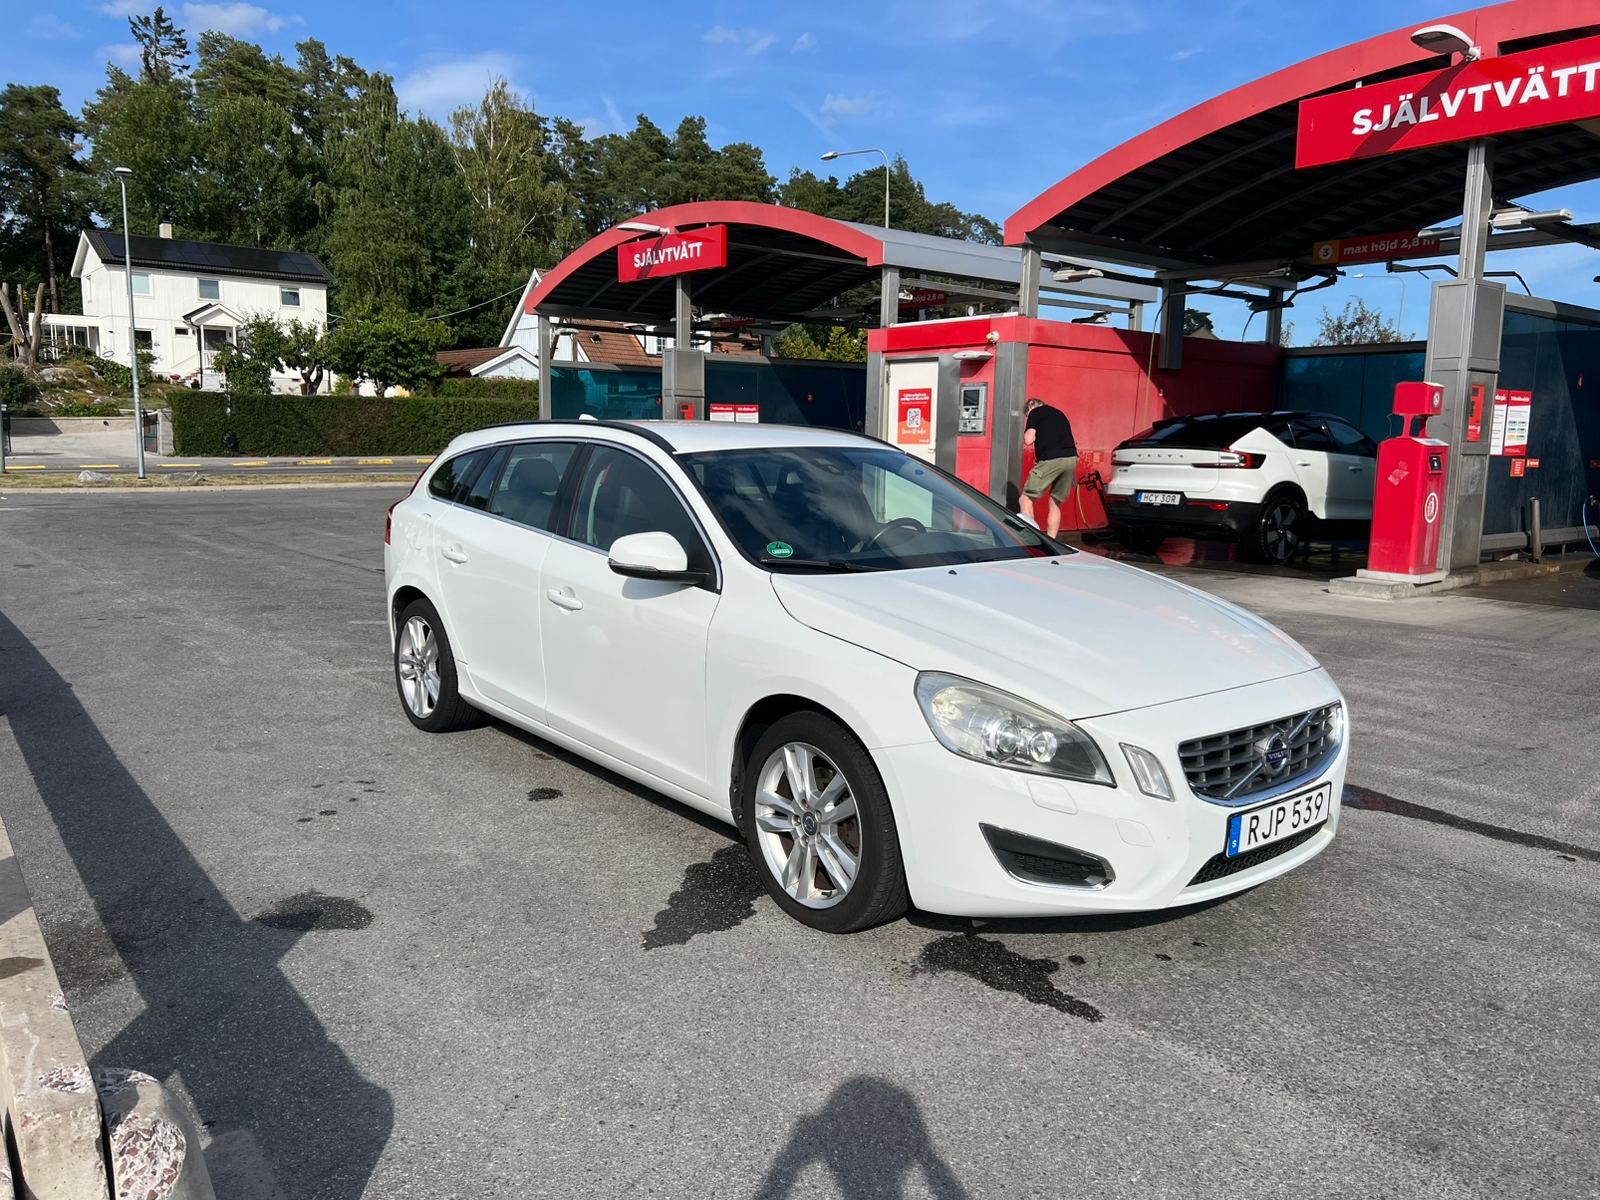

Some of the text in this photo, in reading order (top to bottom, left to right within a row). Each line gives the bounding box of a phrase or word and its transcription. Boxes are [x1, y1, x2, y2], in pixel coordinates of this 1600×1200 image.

[1351, 62, 1600, 135] SJÄLVTVÄTT
[633, 241, 703, 268] SJÄLVTVÄTT
[1322, 247, 1329, 257] 3
[1343, 245, 1368, 255] max
[1371, 240, 1398, 252] höjd
[1401, 237, 1420, 249] 2,8
[1143, 493, 1159, 502] HCY
[1248, 792, 1324, 845] RJP 539
[1231, 839, 1238, 848] S
